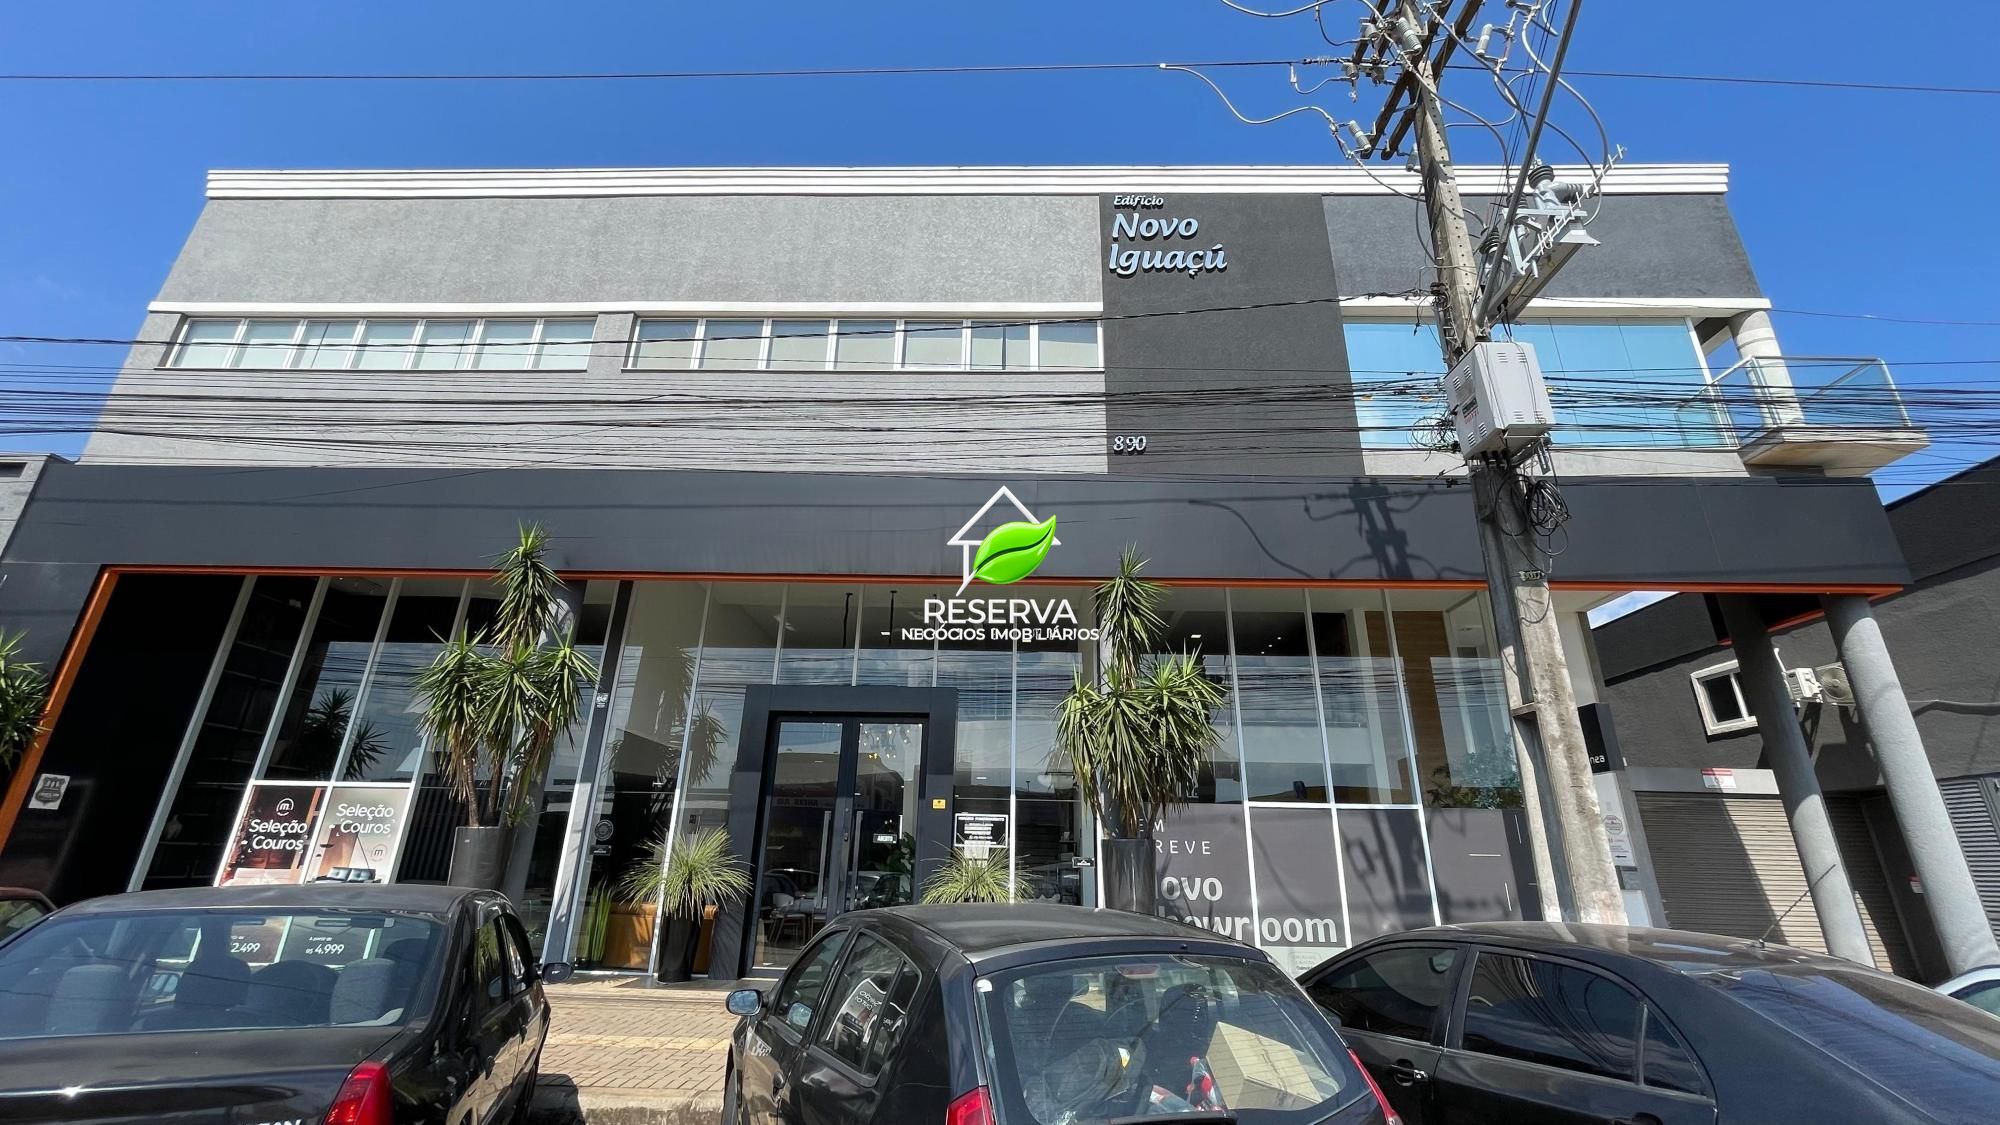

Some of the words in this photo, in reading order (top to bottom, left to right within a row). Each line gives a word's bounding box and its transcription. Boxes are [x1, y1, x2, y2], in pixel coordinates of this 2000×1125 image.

[1112, 212, 1199, 239] Novo
[1108, 242, 1228, 278] Iguaçú
[1113, 435, 1147, 452] 890
[337, 803, 395, 821] Seleção
[249, 819, 308, 837] Seleção
[339, 820, 391, 834] Couros
[252, 836, 304, 851] Couros
[1154, 839, 1212, 855] REVE
[1155, 876, 1223, 902] ovo
